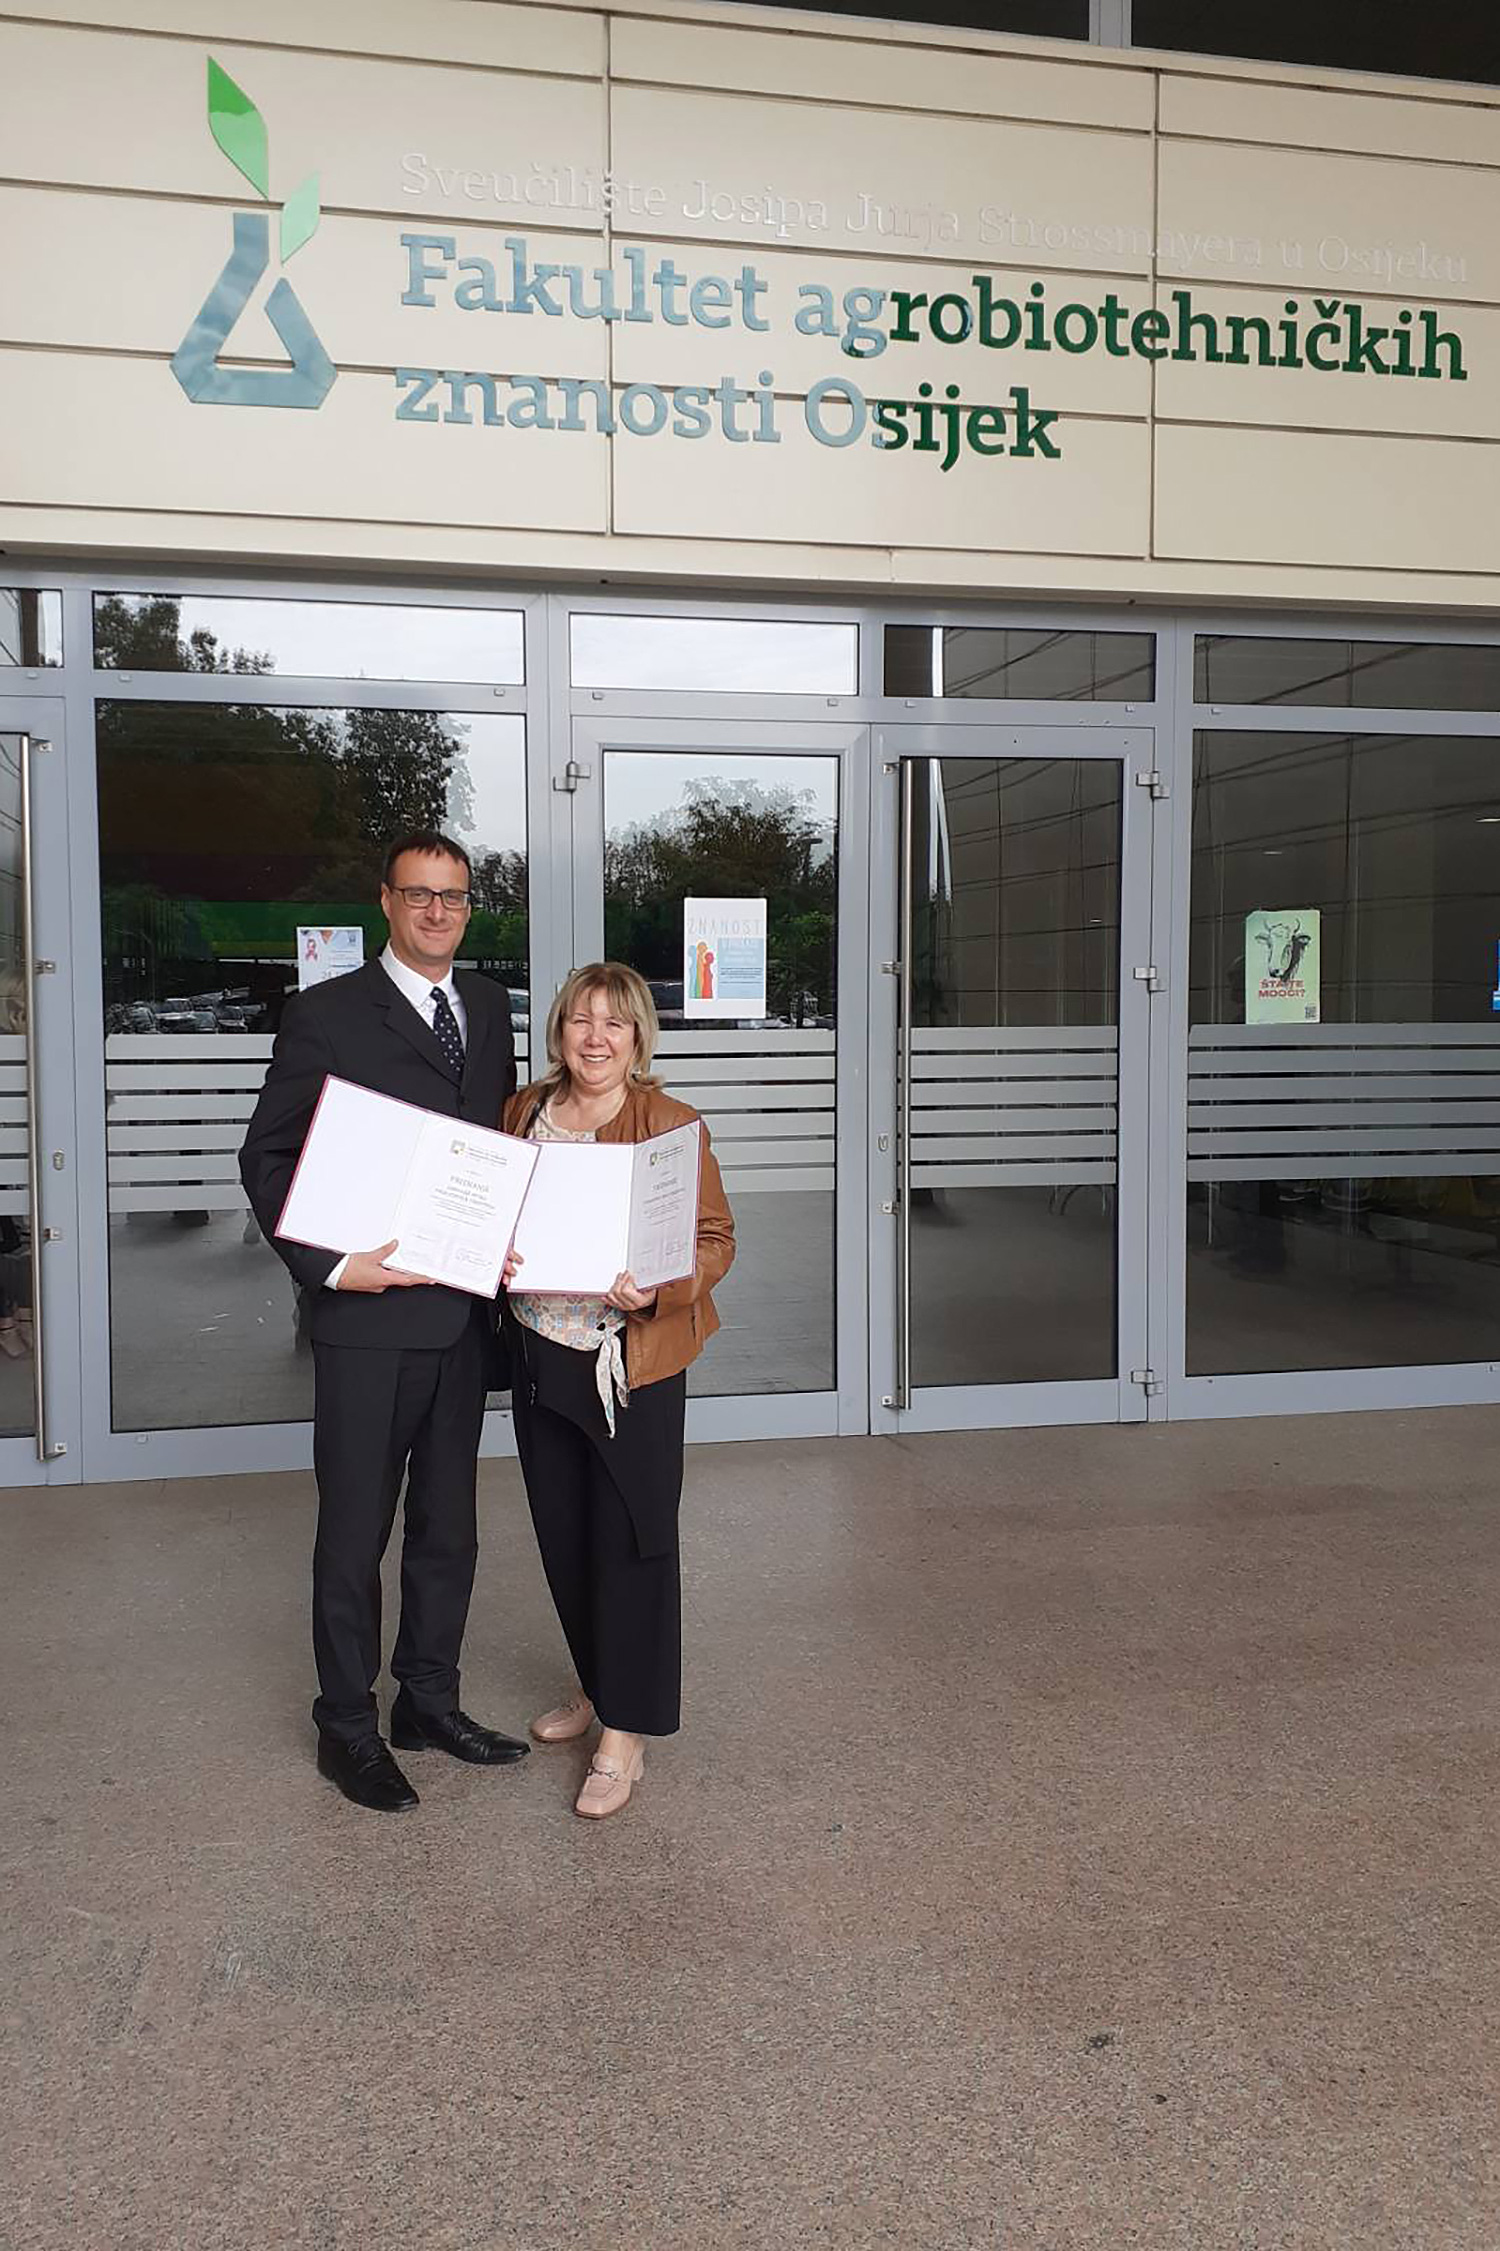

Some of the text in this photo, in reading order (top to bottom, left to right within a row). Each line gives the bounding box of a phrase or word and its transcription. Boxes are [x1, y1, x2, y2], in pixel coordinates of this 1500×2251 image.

[400, 153, 667, 217] Sveučilište
[682, 179, 829, 238] Josipa
[845, 192, 963, 252] Jurja
[1277, 239, 1304, 270] u
[1317, 234, 1469, 284] Osijeku
[400, 232, 1468, 381] Fakultet agrobiotehničkih
[395, 366, 1062, 473] znanosti Osijek
